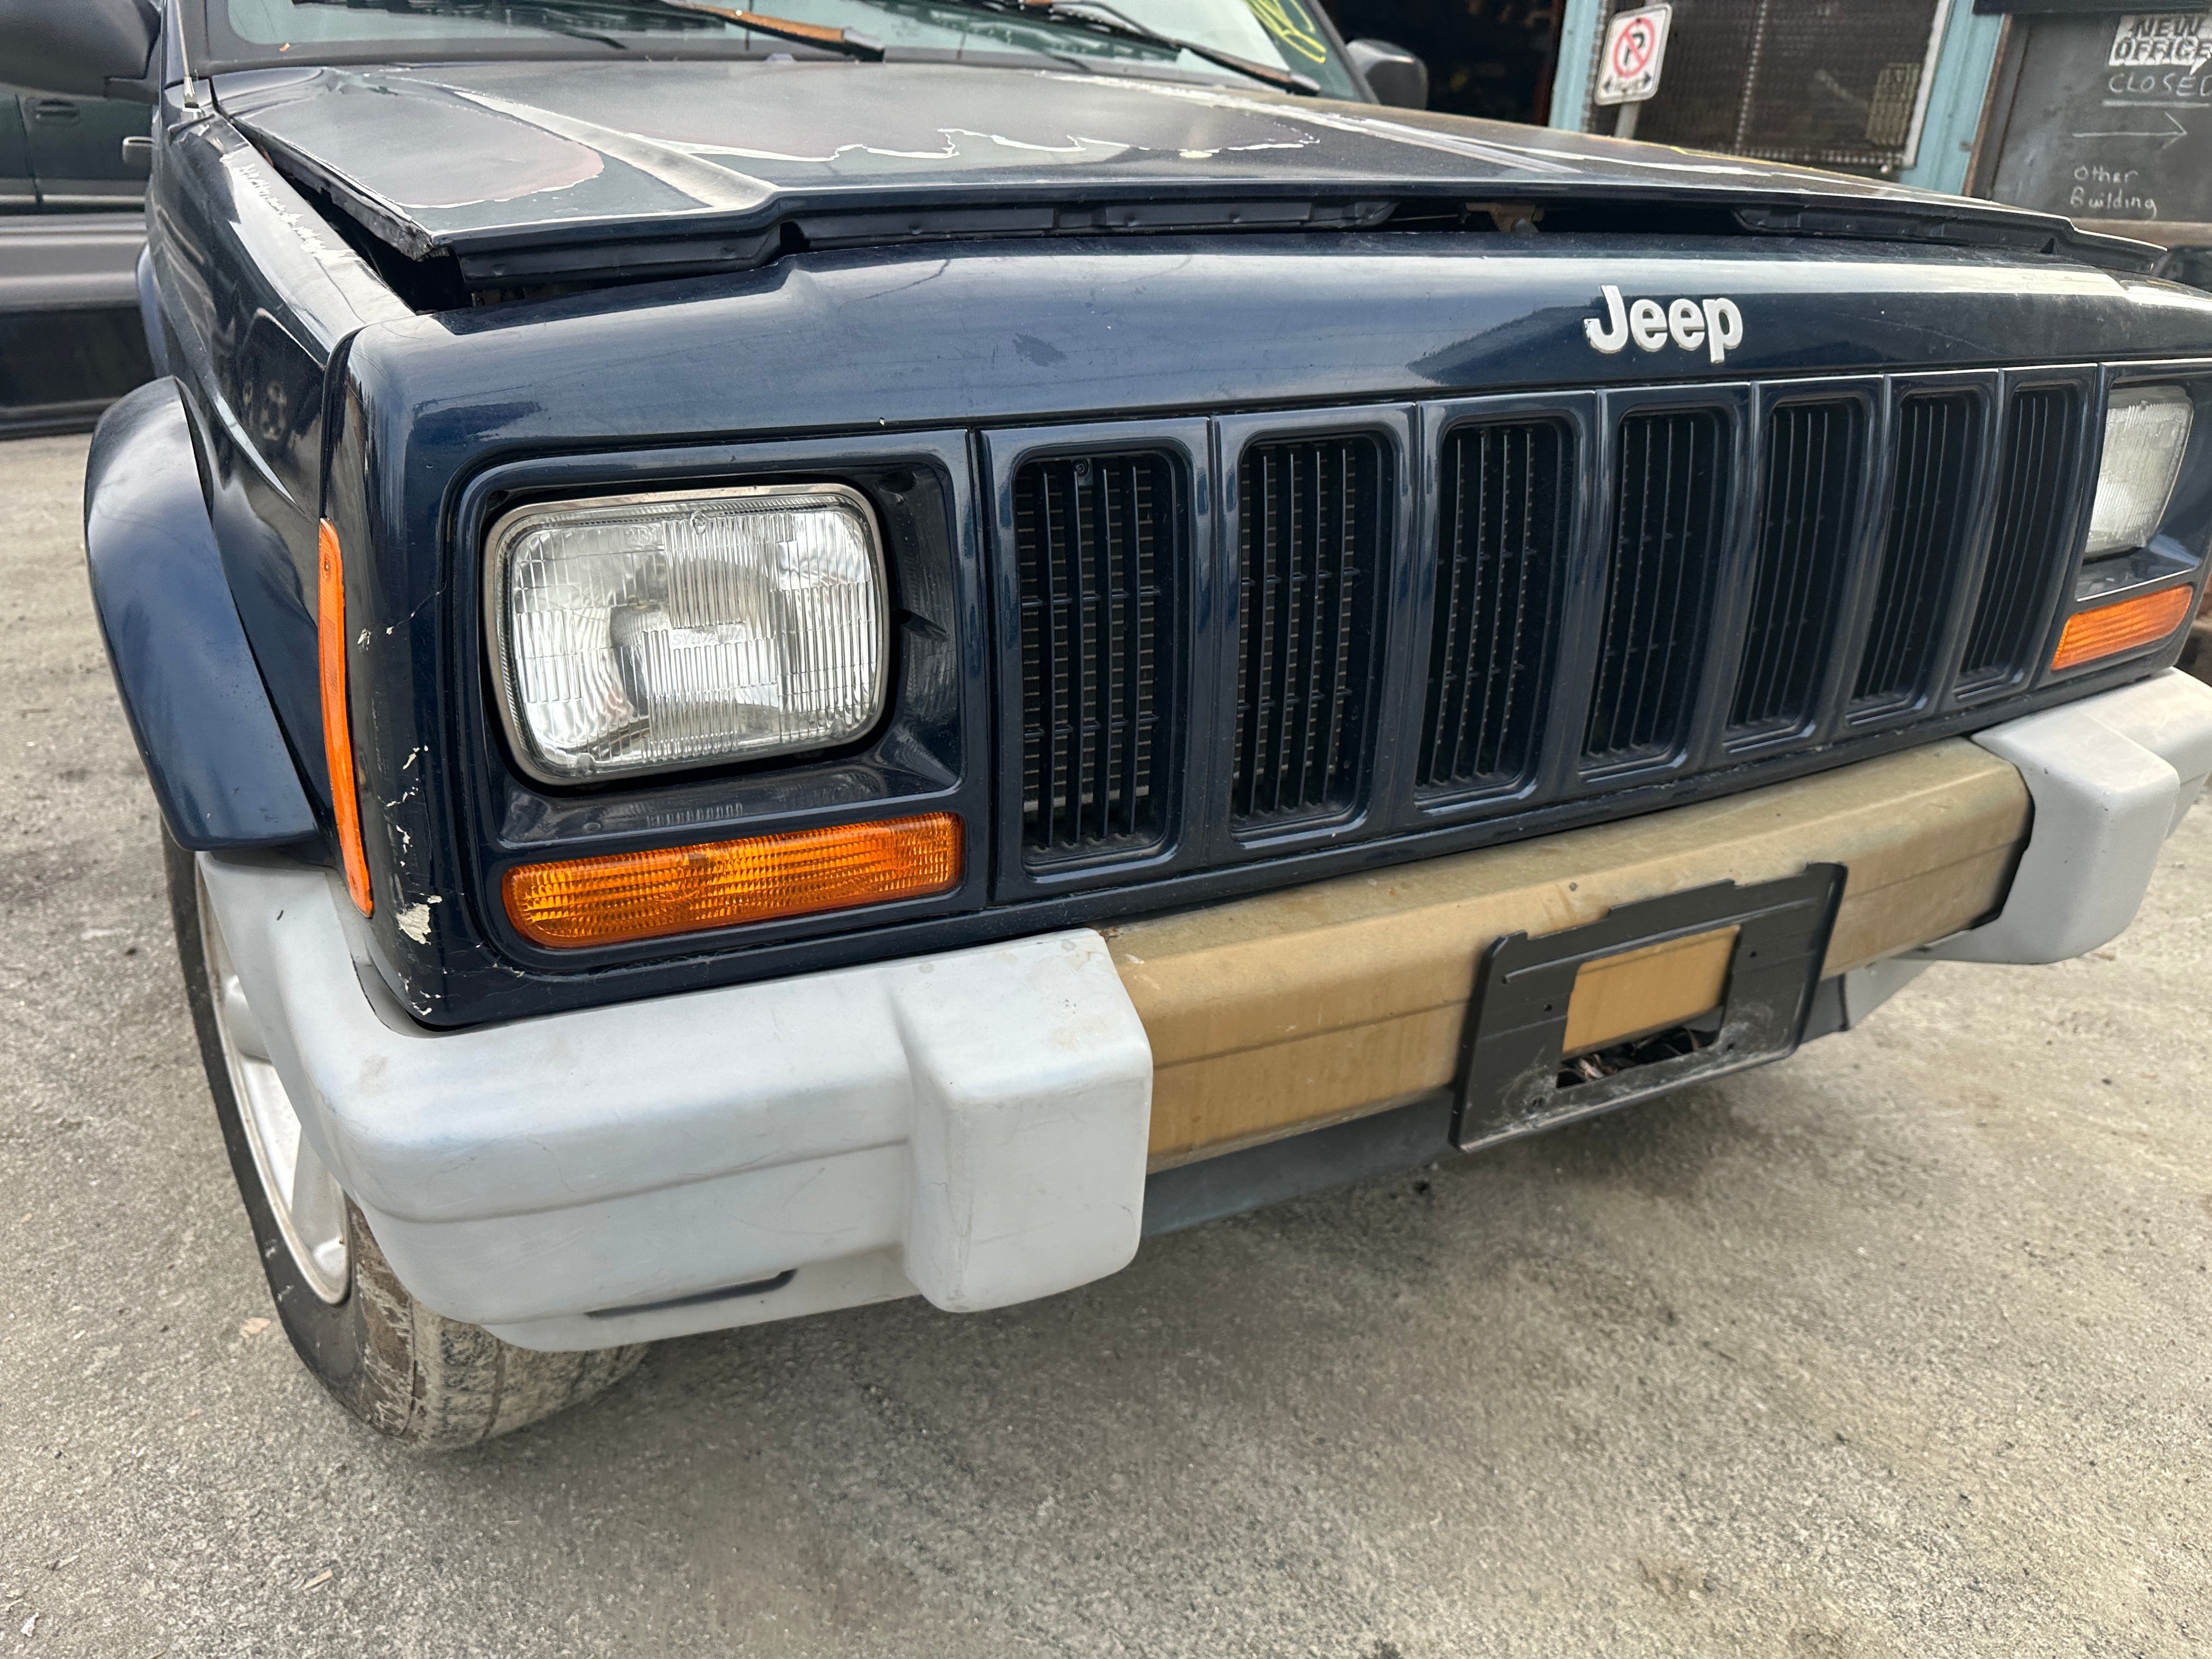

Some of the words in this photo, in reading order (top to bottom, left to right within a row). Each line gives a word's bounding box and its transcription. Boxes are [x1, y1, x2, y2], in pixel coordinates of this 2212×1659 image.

[2131, 16, 2203, 39] NEW
[2074, 165, 2138, 184] Other
[2070, 185, 2157, 219] Building
[1584, 285, 1744, 364] Jeep
[671, 626, 744, 646] SYLVANIA
